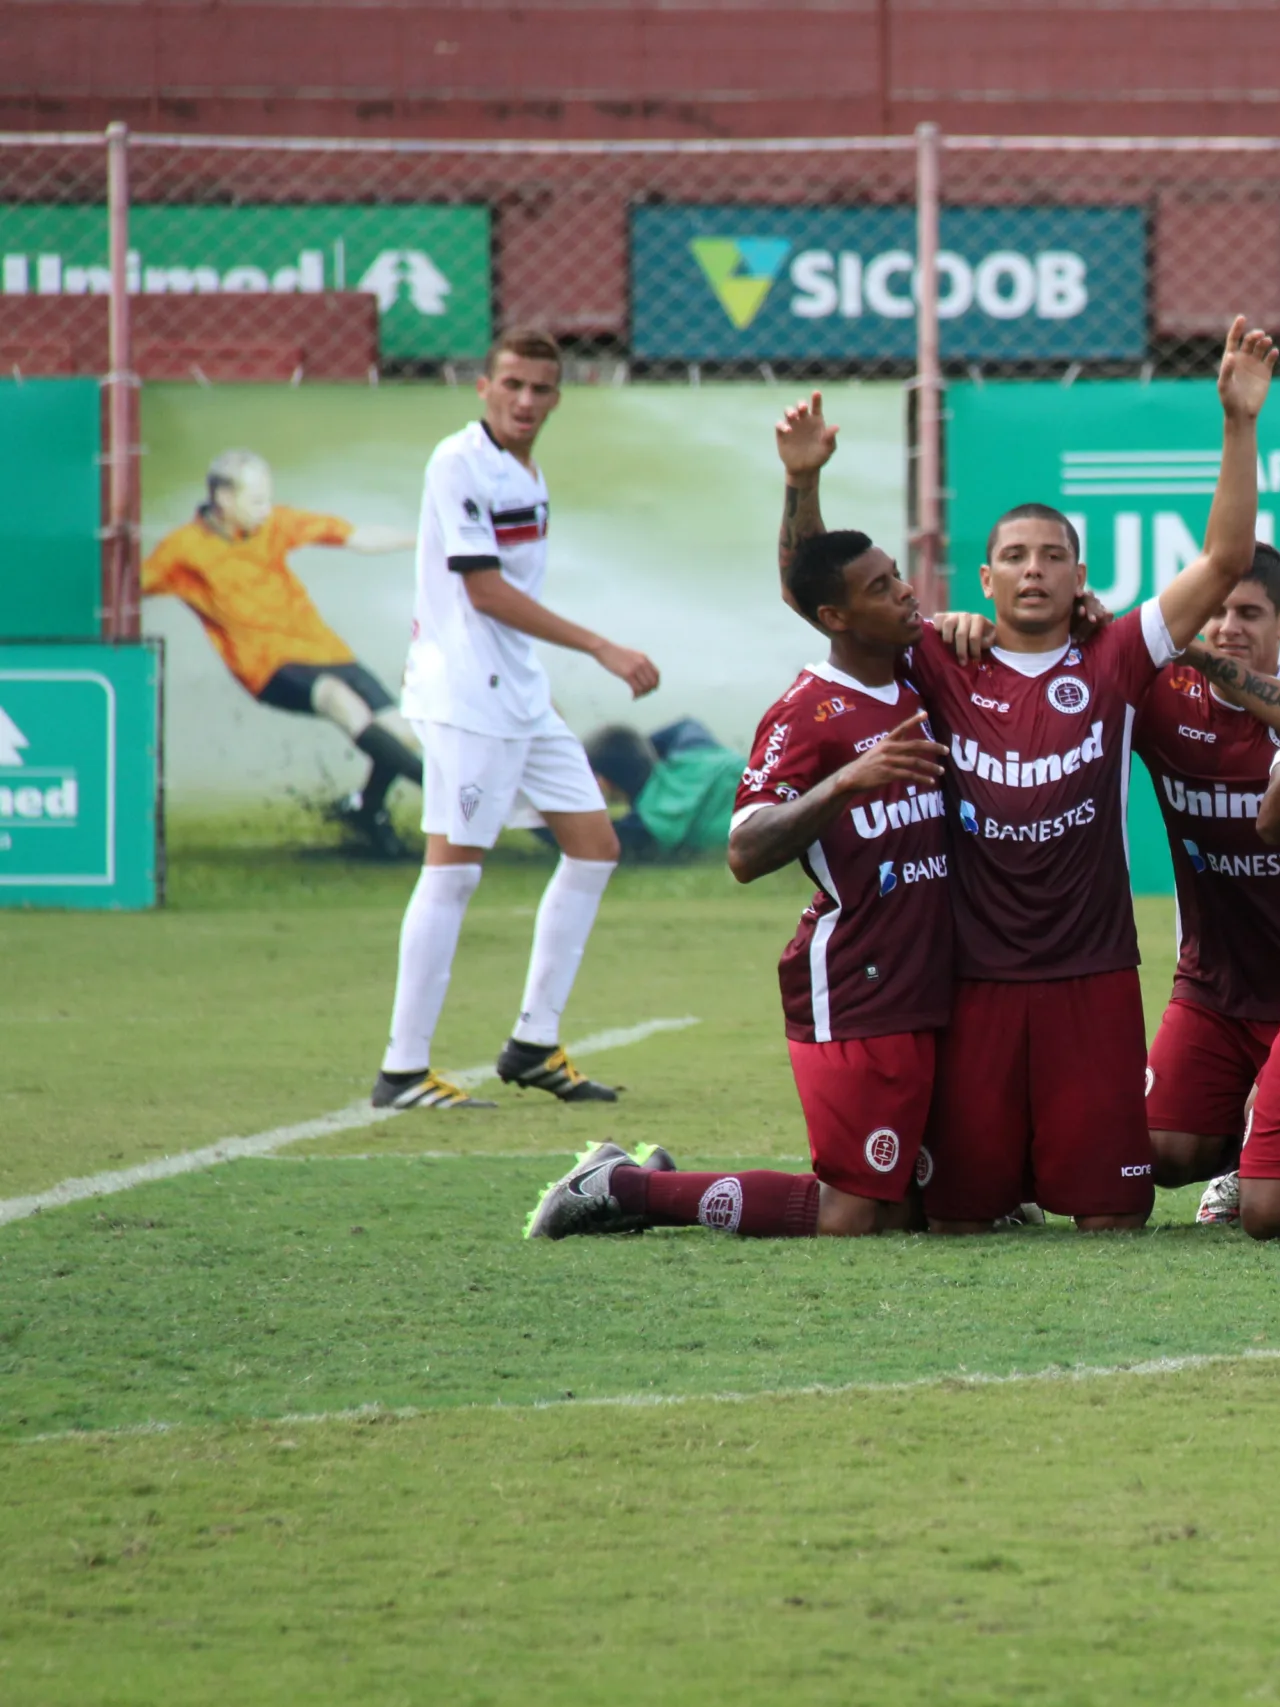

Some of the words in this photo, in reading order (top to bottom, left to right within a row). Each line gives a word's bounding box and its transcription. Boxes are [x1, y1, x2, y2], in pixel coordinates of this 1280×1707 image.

[790, 250, 1089, 318] SICOOB
[951, 720, 1104, 787] Unimed
[985, 798, 1096, 843] BANESTES
